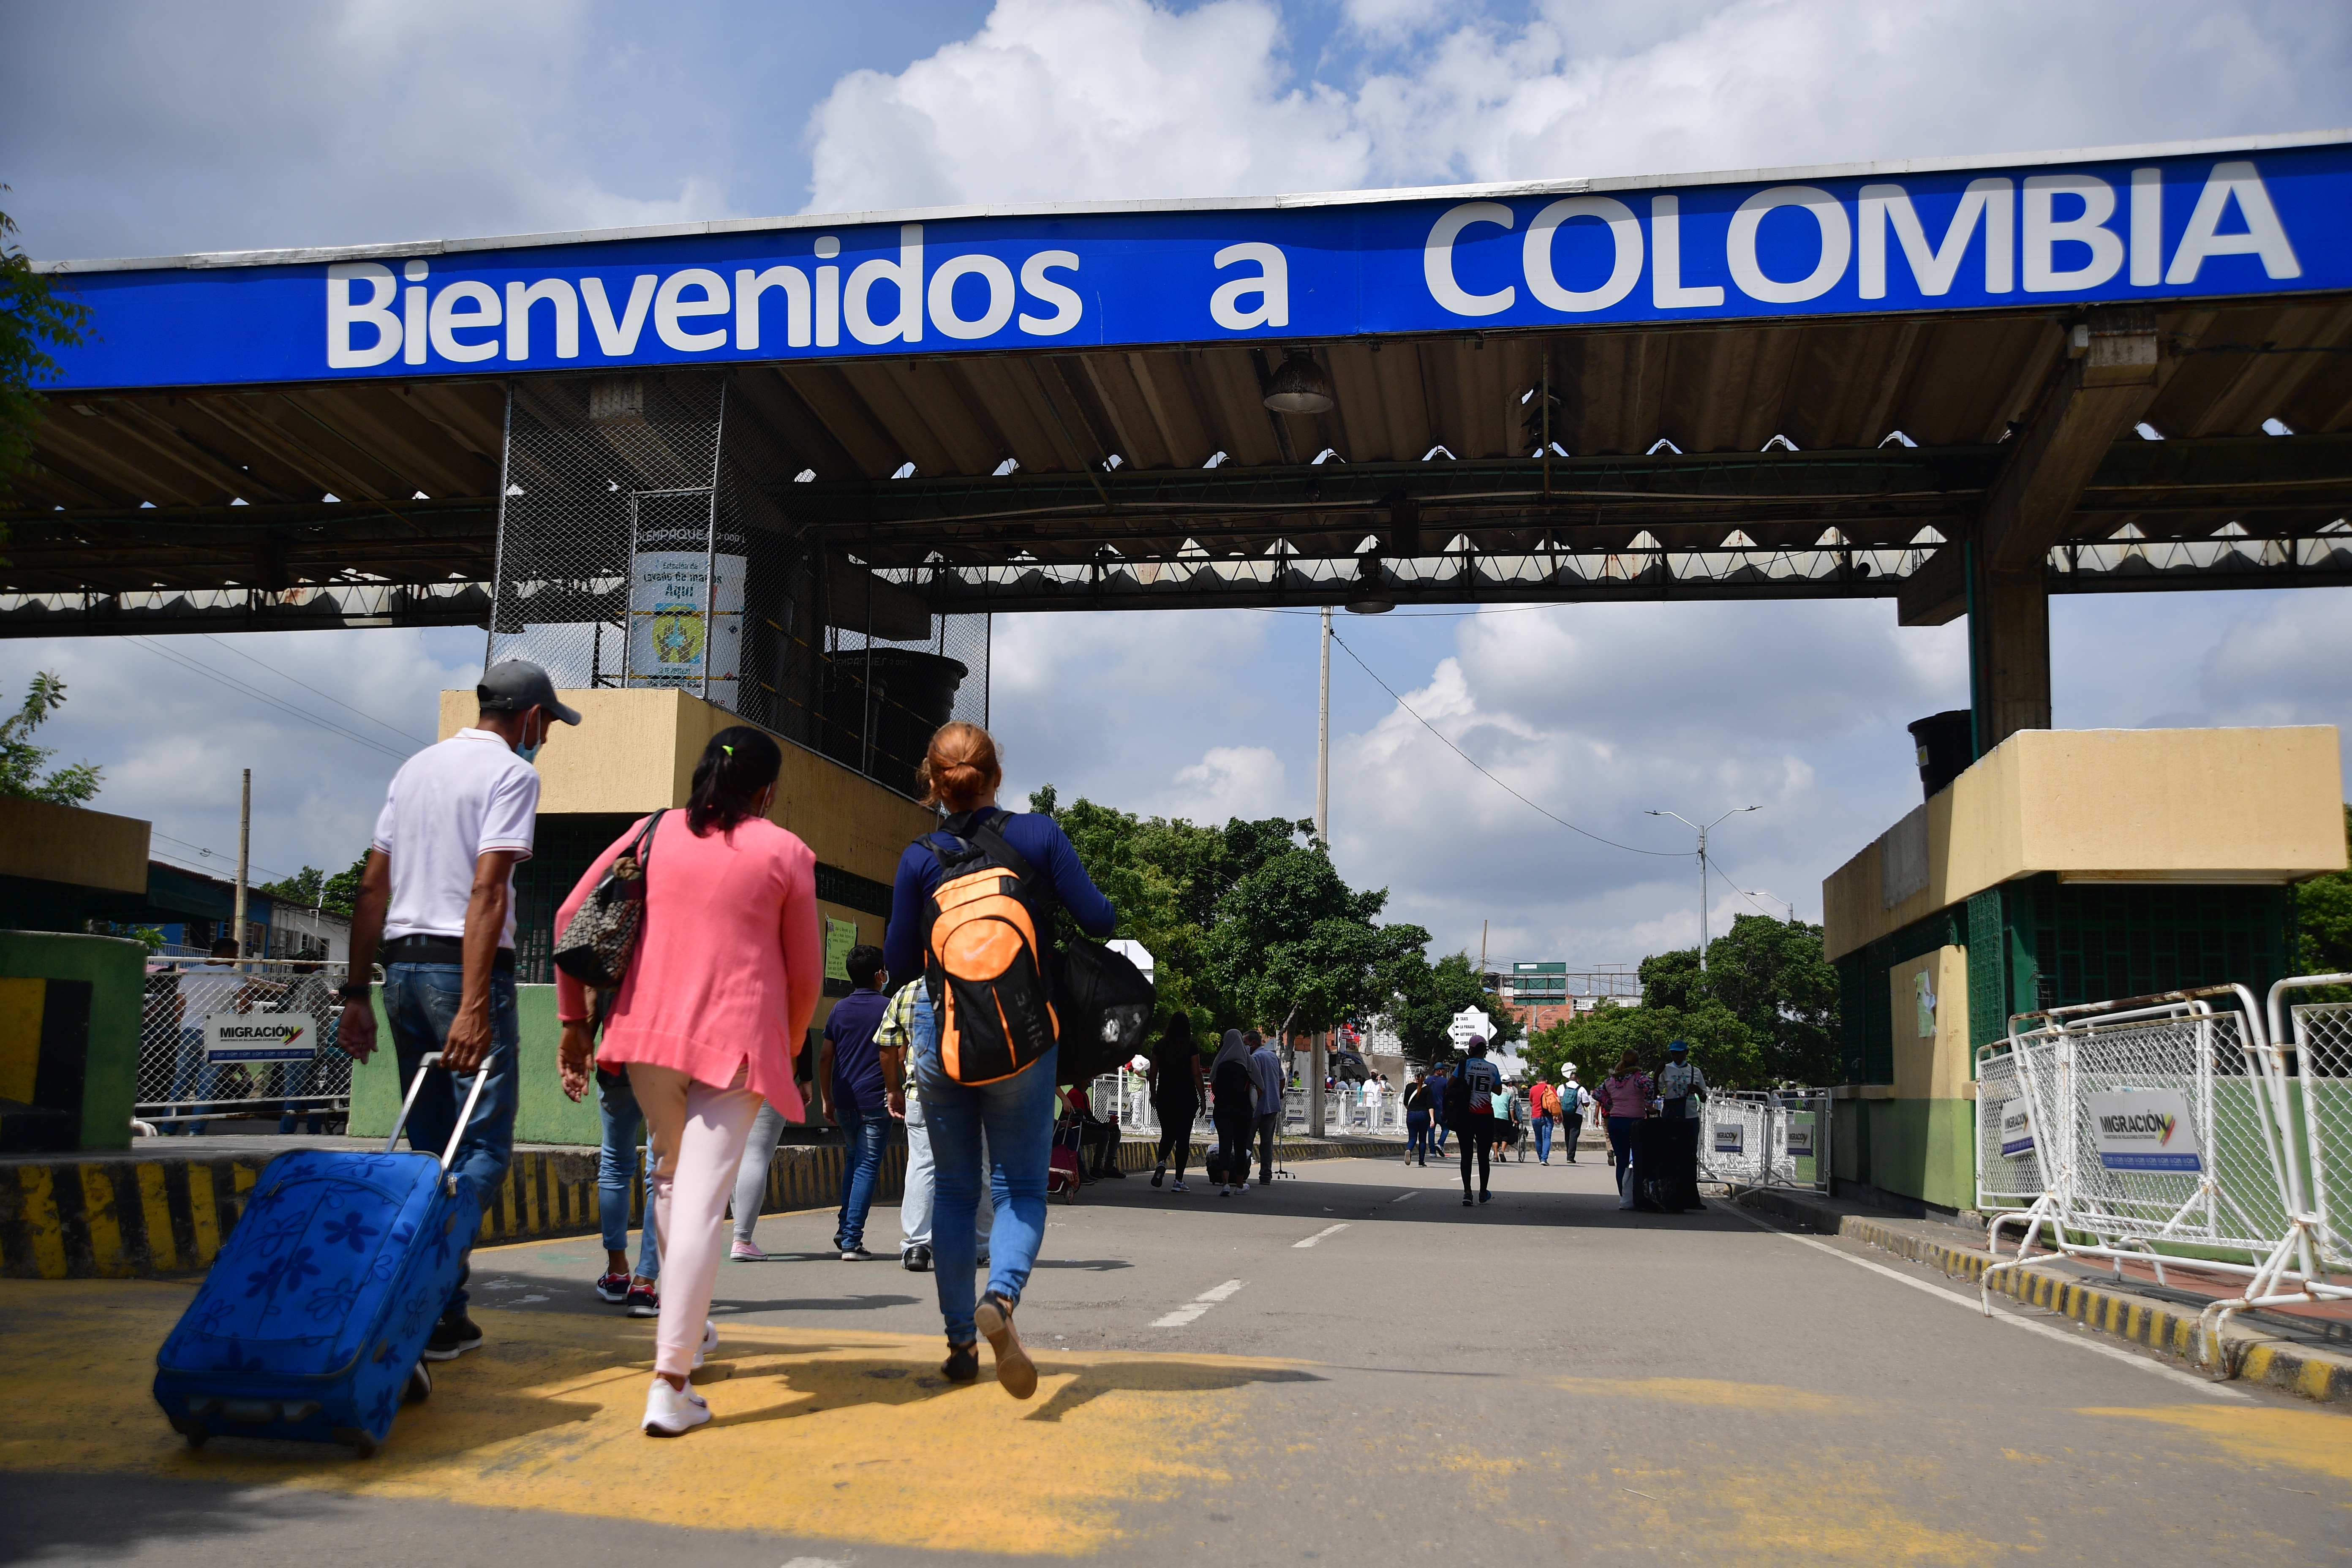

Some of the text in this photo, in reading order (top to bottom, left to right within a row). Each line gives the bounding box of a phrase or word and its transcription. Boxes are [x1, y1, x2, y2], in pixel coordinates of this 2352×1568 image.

[327, 160, 2302, 369] Bienvenidos a COLOMBIA
[643, 572, 672, 583] Lavado
[675, 572, 687, 582] de
[220, 1023, 294, 1038] MIGRACIÓN
[1467, 1073, 1491, 1094] 16
[2099, 1109, 2167, 1133] MIGRACIÓN
